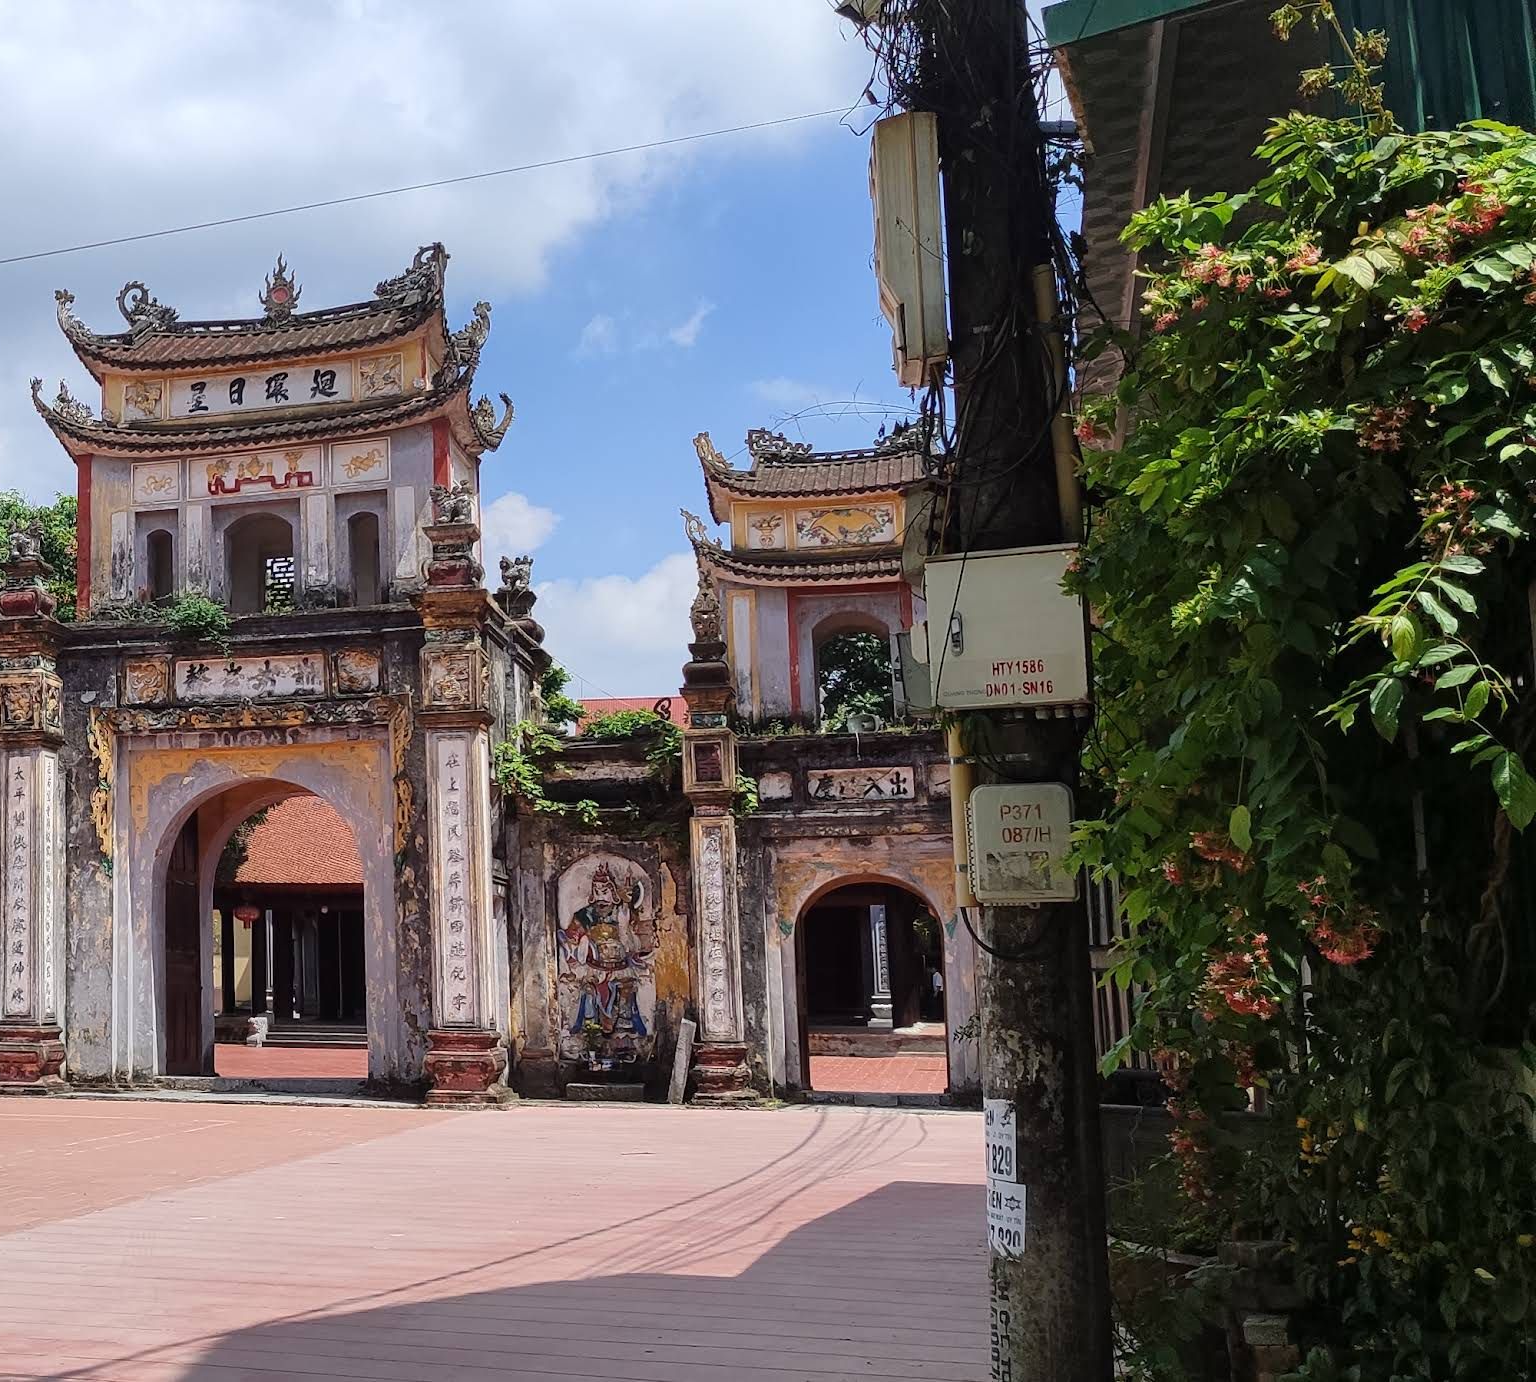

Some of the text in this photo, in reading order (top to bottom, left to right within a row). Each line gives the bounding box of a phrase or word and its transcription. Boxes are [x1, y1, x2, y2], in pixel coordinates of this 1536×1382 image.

[991, 659, 1044, 677] HTY1586
[985, 680, 1054, 698] DN01-SN16
[999, 803, 1042, 821] P371
[1001, 826, 1052, 844] 087/H
[992, 1143, 1013, 1176] 829
